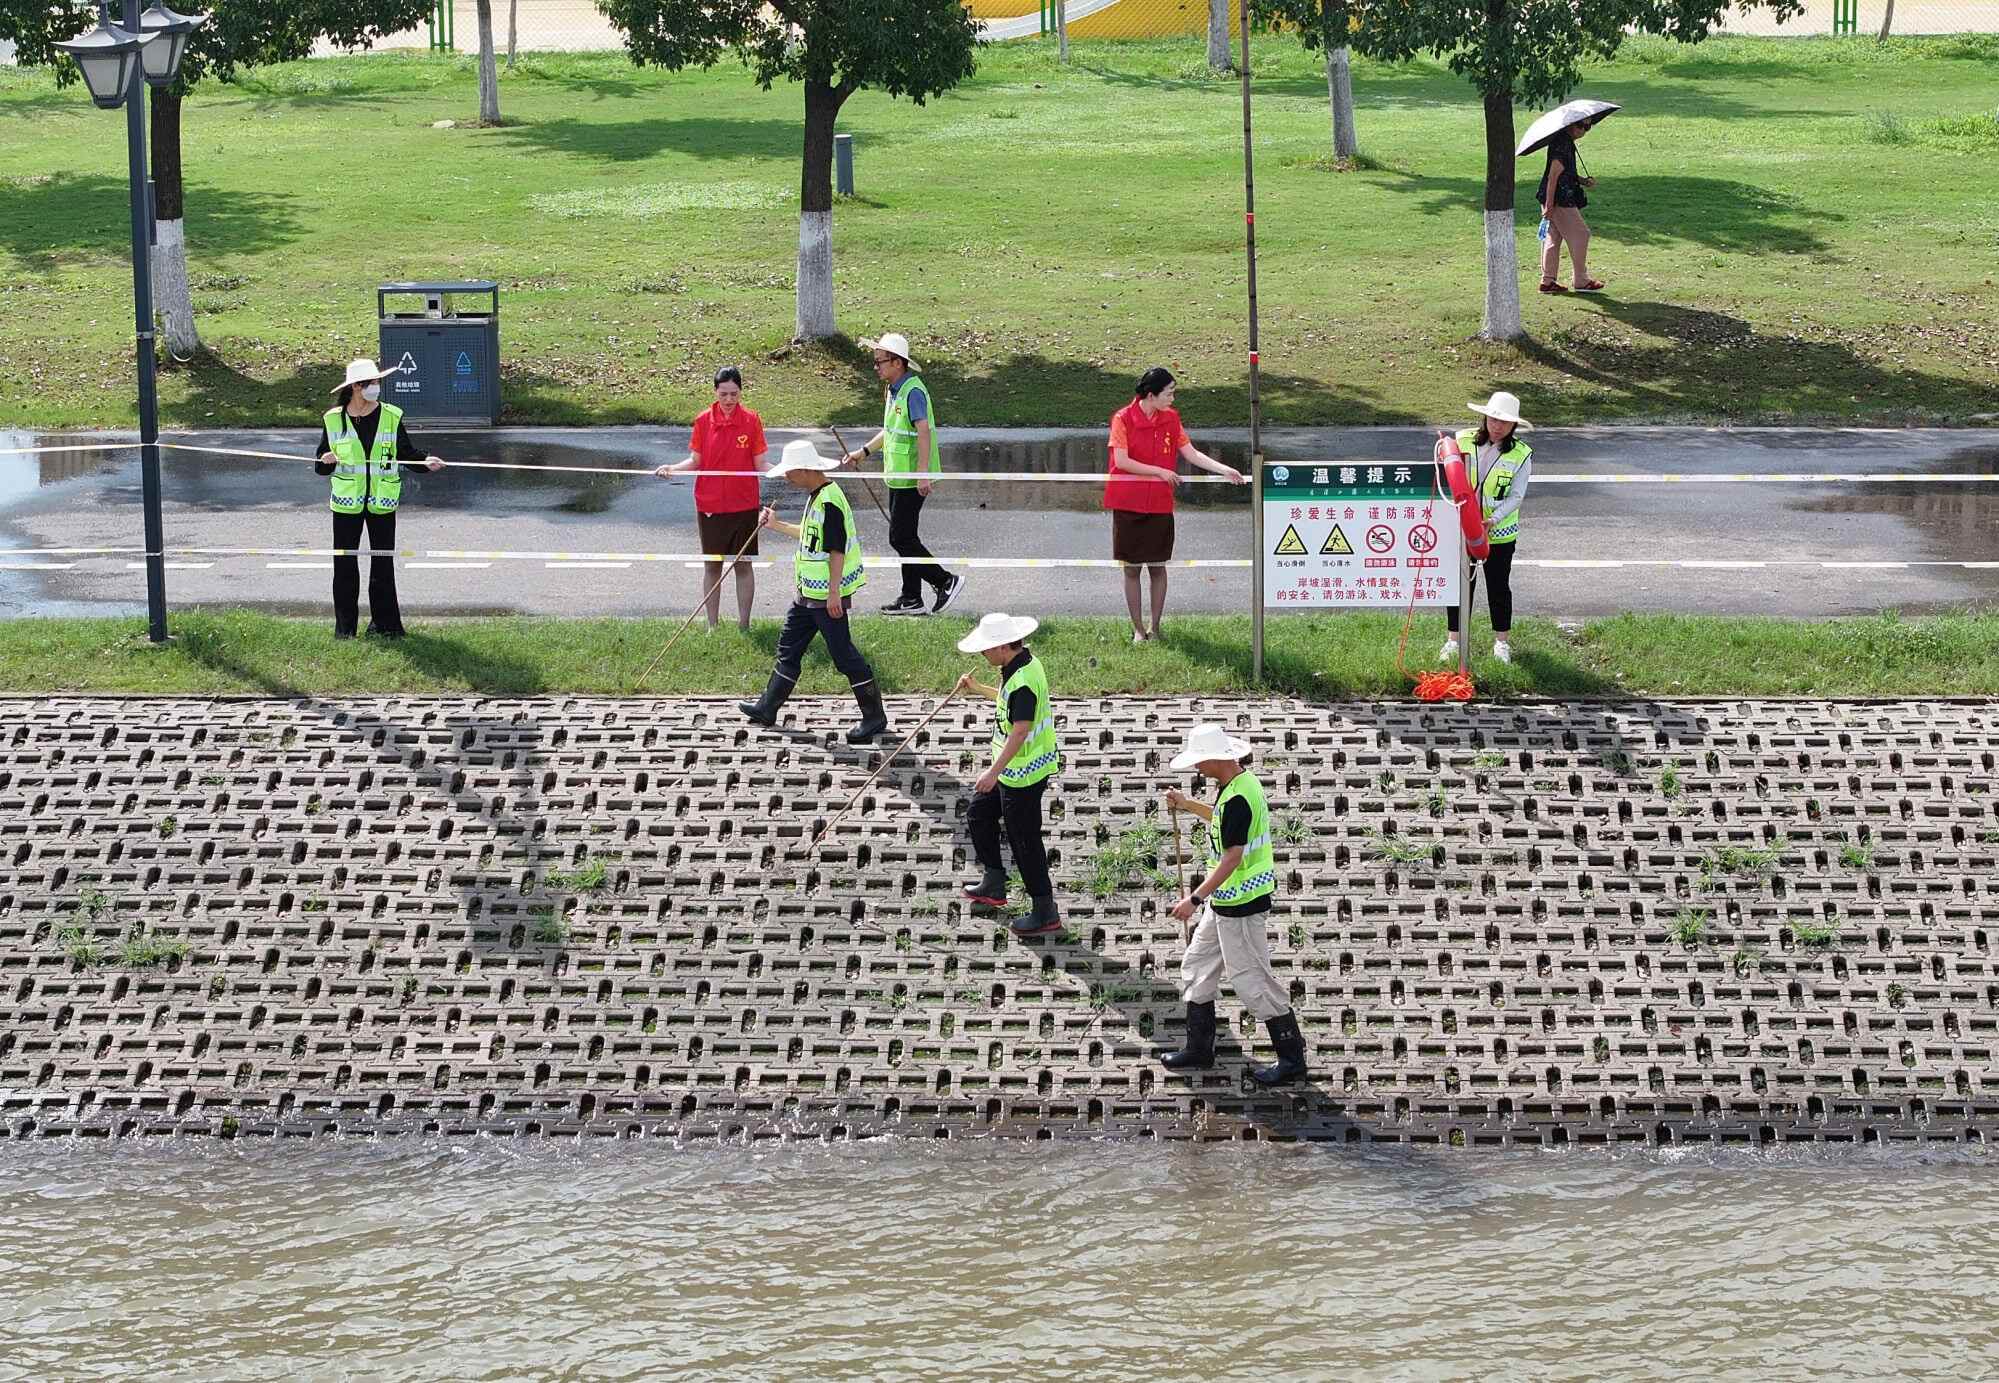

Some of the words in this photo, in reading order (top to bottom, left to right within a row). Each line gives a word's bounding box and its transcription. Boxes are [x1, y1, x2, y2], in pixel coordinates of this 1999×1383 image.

[1312, 467, 1412, 484] 温馨提示
[1290, 506, 1355, 520] 珍爱生命
[1368, 506, 1433, 520] 谨防溺水
